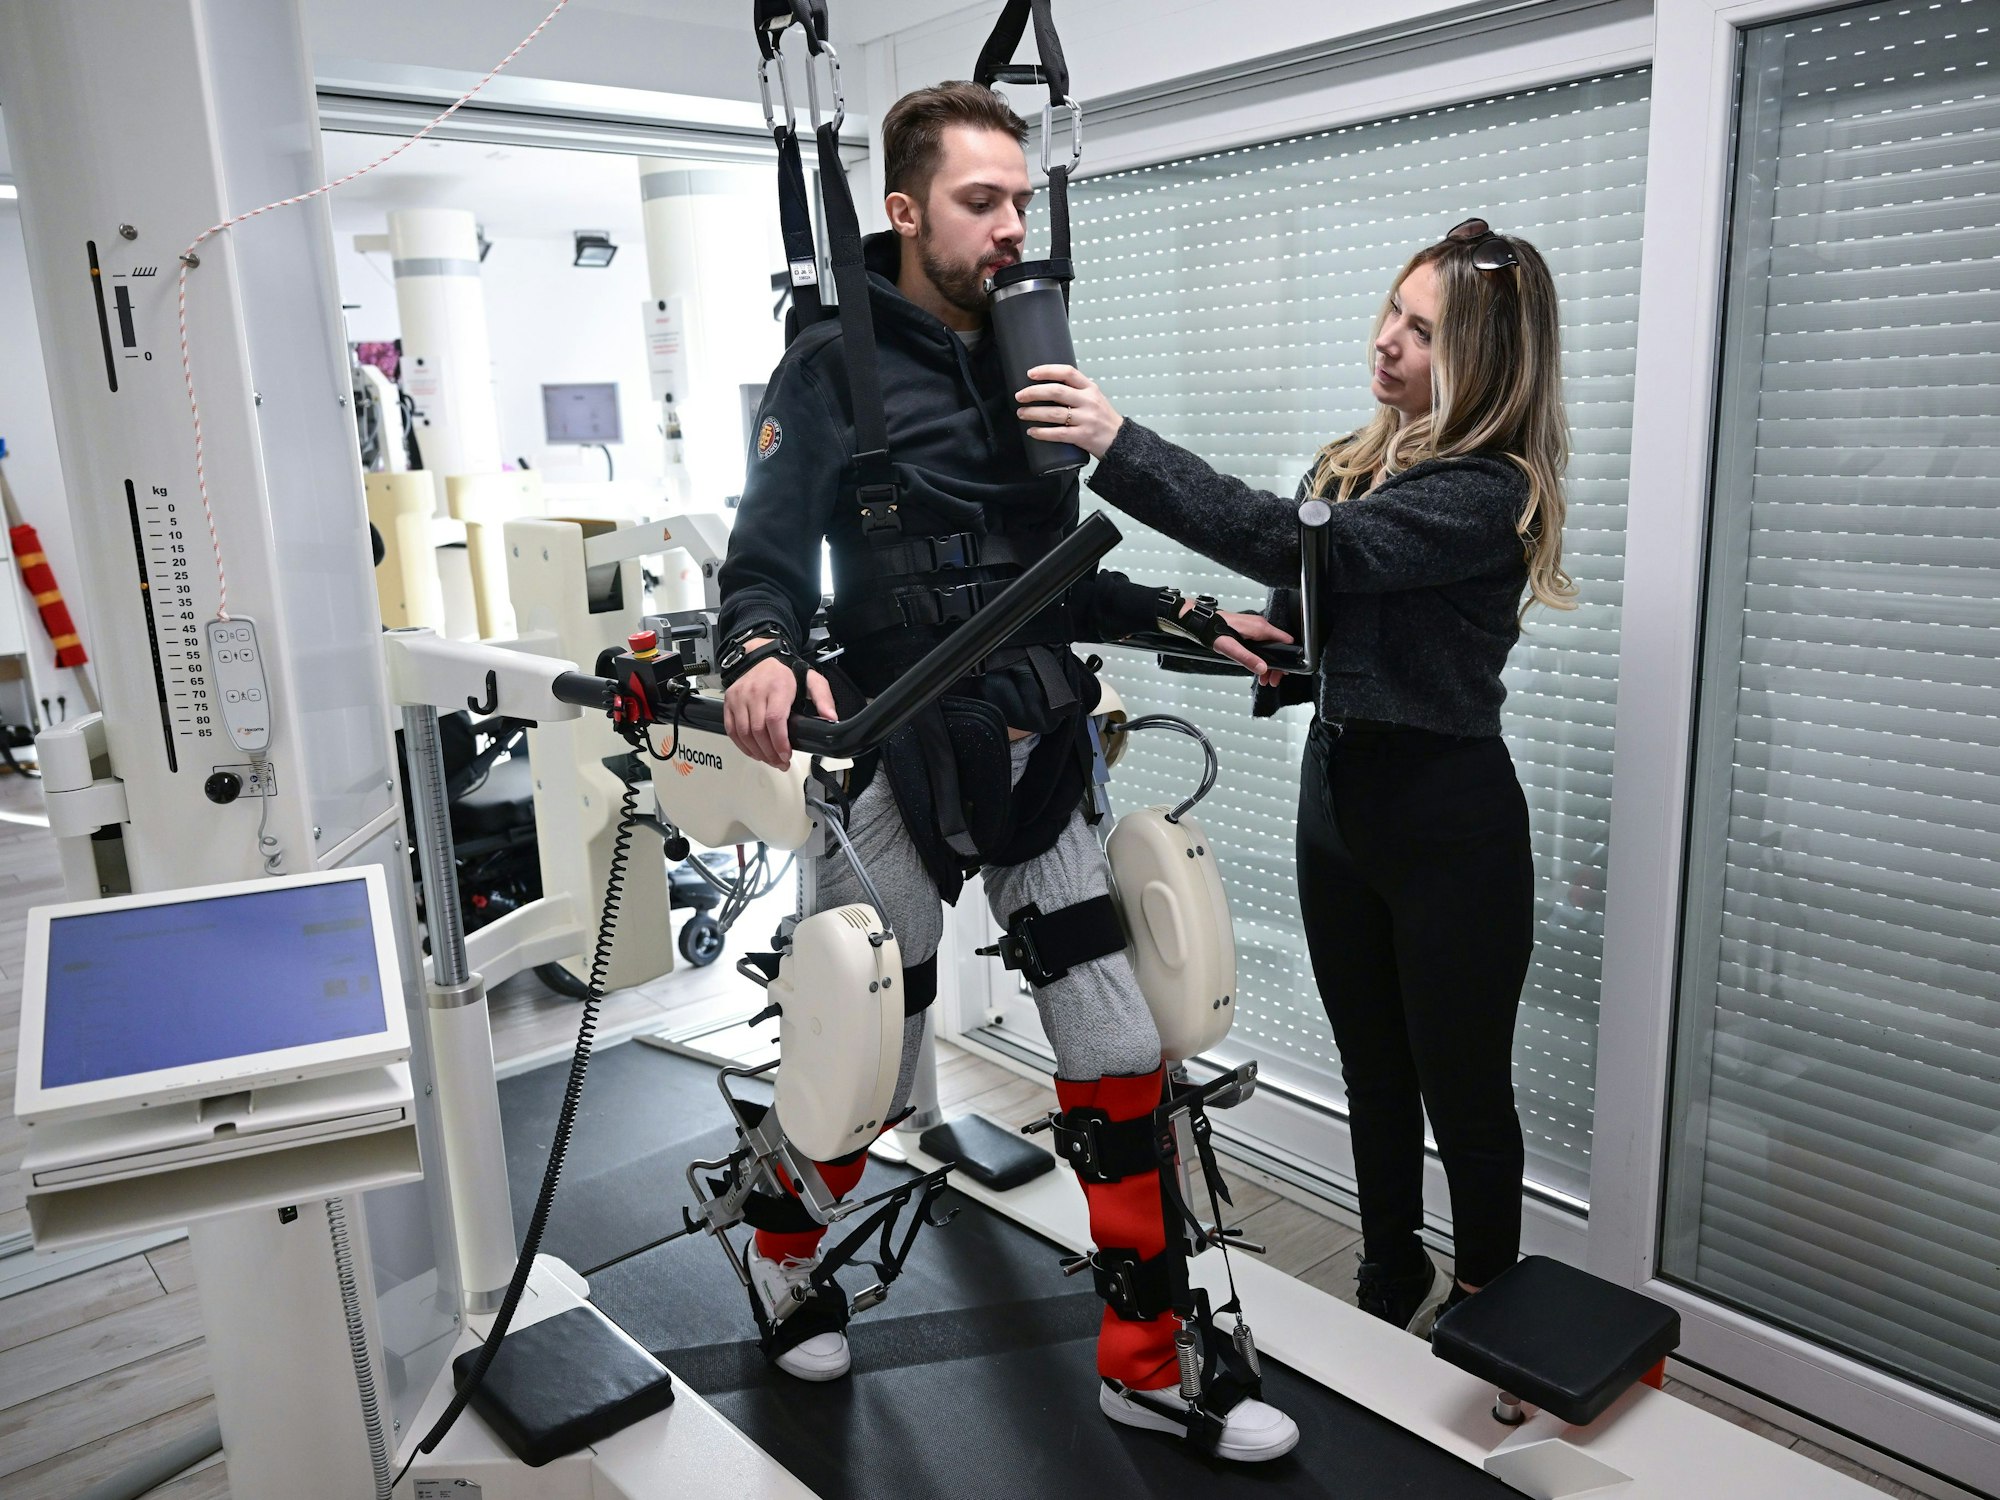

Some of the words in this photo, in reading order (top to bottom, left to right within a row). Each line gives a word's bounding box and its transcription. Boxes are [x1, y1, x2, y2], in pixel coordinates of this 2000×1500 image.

[144, 352, 153, 361] 0
[152, 486, 168, 498] kg
[167, 504, 176, 512] 0
[169, 518, 178, 526] 5
[168, 531, 183, 539] 10
[170, 545, 185, 553] 15
[172, 558, 187, 566] 20
[174, 572, 189, 580] 25
[176, 585, 191, 593] 30
[178, 598, 193, 606] 35
[180, 612, 195, 620] 40
[182, 625, 197, 633] 45
[184, 638, 199, 646] 50
[186, 651, 201, 659] 55
[188, 664, 203, 672] 60
[190, 677, 205, 685] 65
[192, 690, 207, 698] 70
[194, 703, 209, 711] 75
[196, 716, 211, 724] 80
[198, 729, 213, 737] 85
[678, 743, 723, 770] Hocoma
